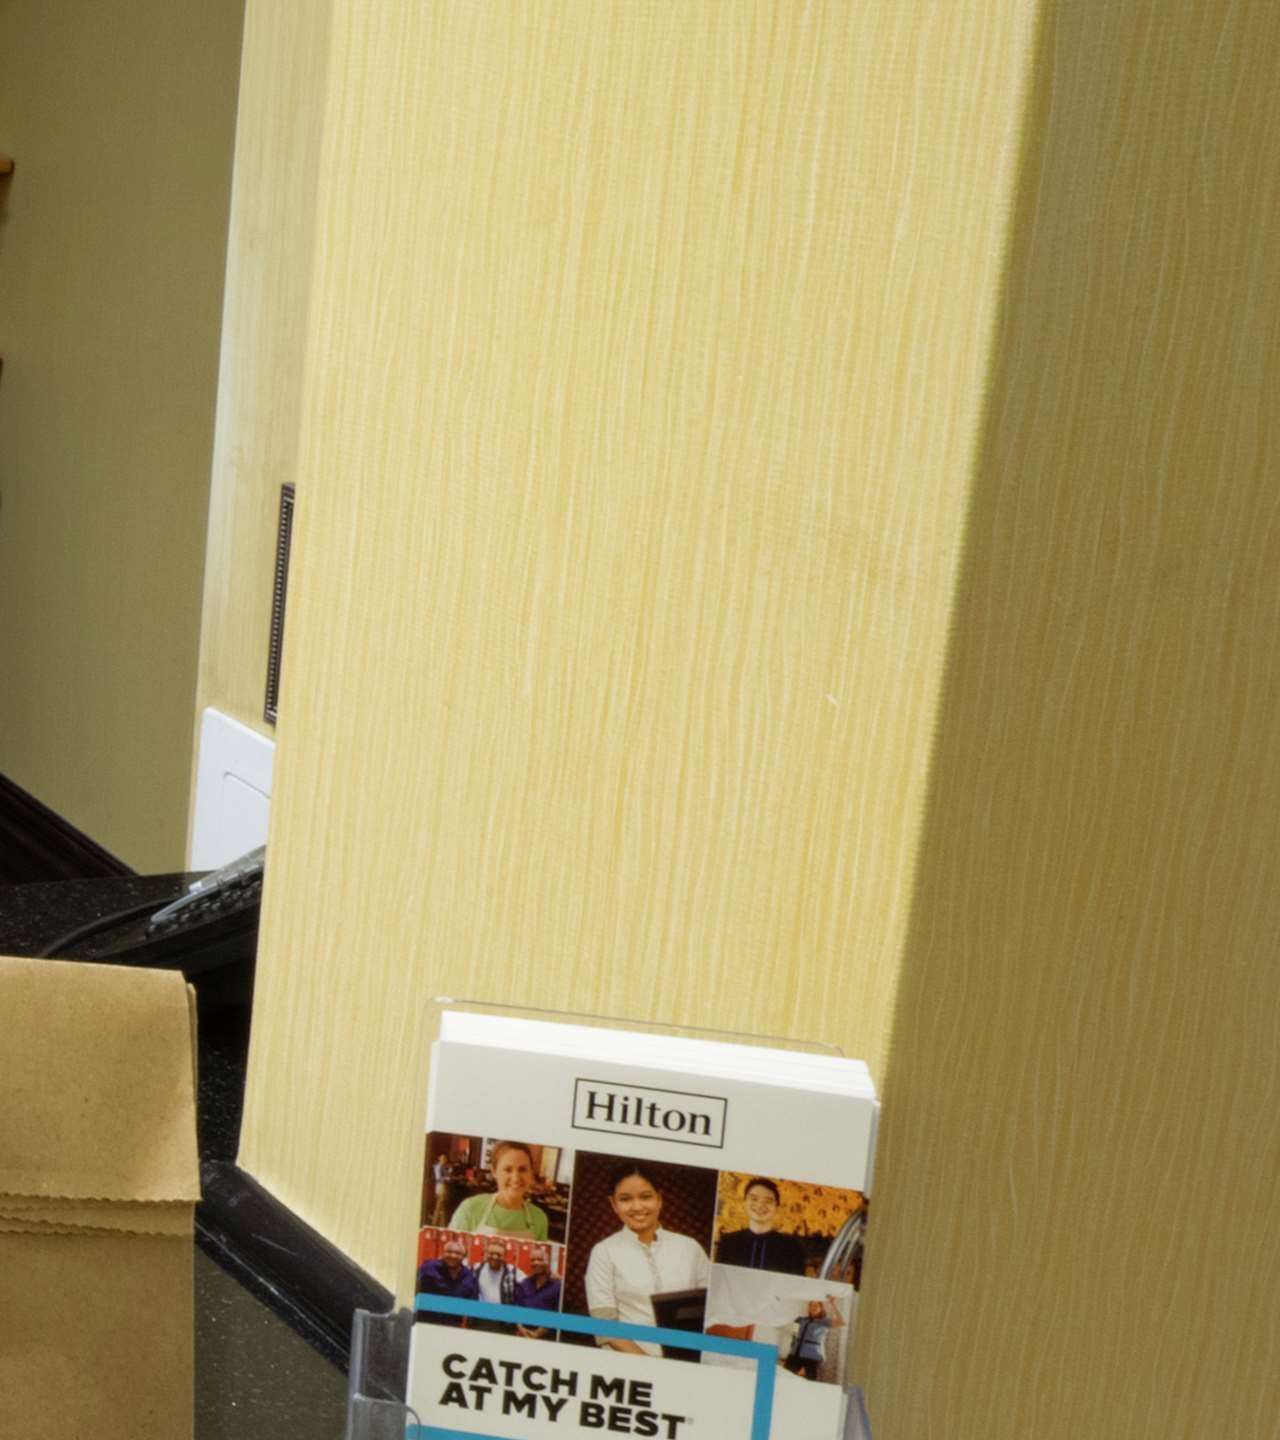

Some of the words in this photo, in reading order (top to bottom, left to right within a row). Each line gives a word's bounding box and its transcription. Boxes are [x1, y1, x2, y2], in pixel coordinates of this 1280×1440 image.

[585, 1090, 713, 1135] Hilton
[439, 1381, 496, 1412] AT
[501, 1391, 566, 1424] MY
[441, 1353, 577, 1396] CATCH
[590, 1374, 653, 1407] ME
